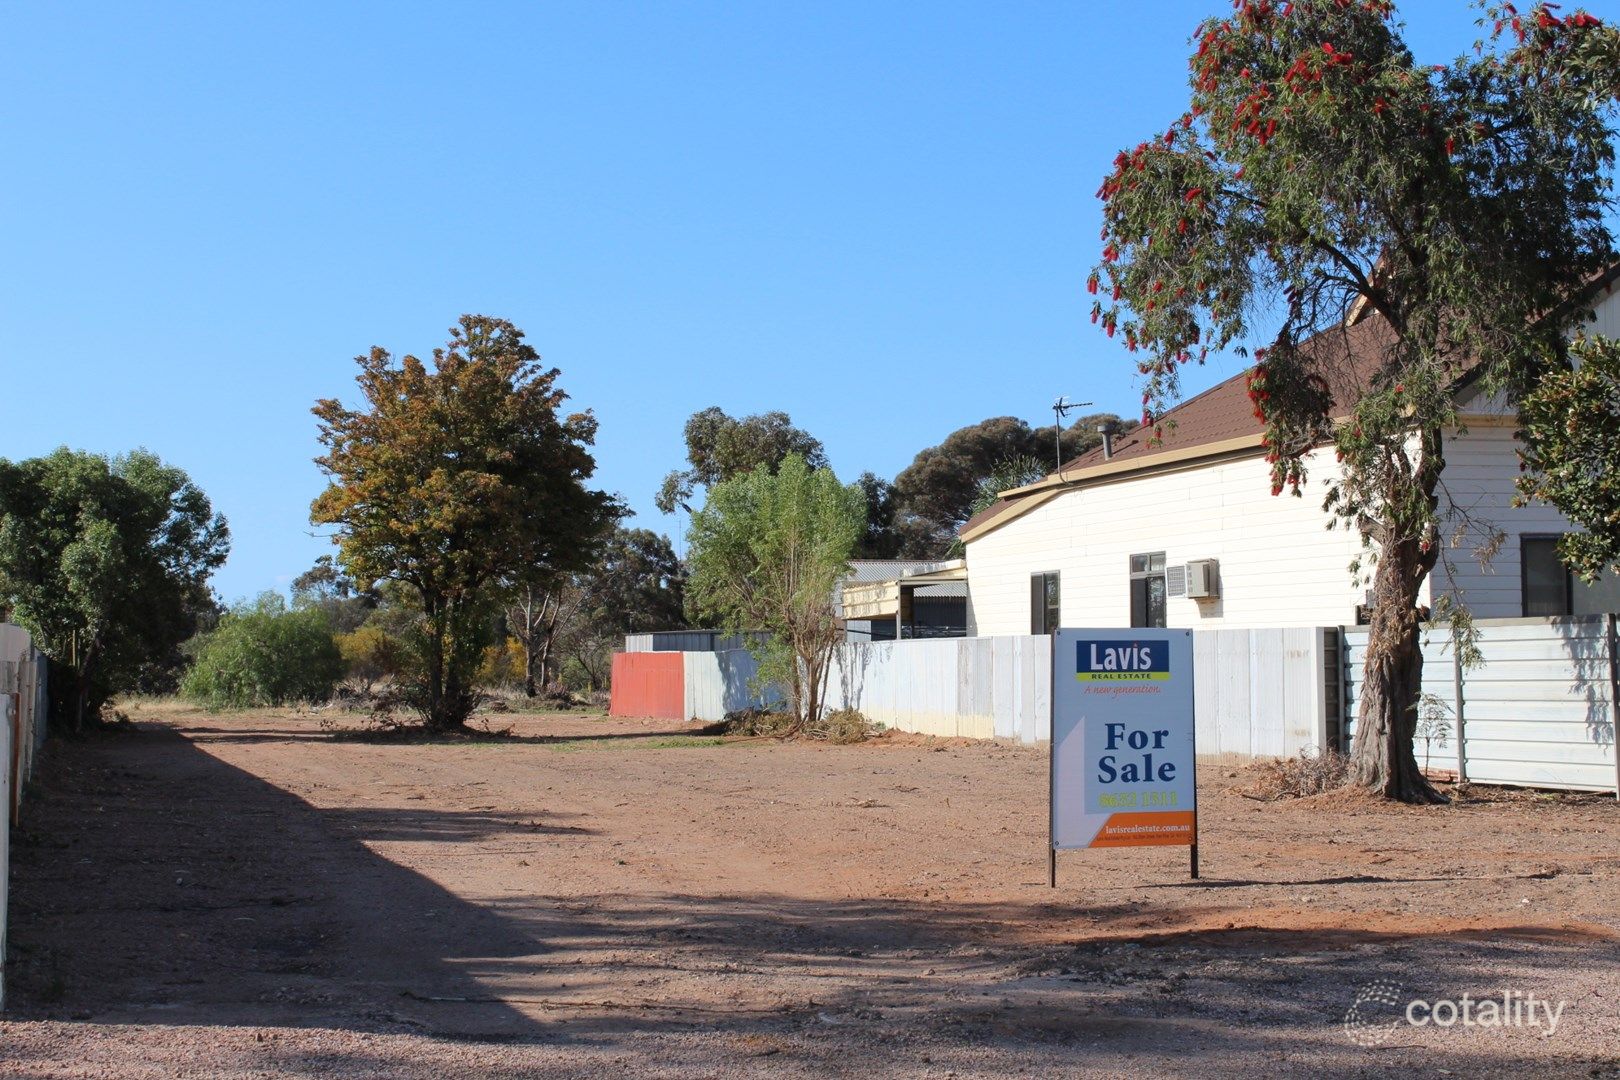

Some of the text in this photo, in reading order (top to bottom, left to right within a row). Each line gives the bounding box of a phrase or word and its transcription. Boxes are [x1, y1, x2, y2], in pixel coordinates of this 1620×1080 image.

[1090, 642, 1152, 671] Lavis
[1084, 686, 1091, 694] A
[1104, 722, 1170, 751] For
[1097, 753, 1176, 784] Sale
[1105, 825, 1190, 834] lavisrealestate.com.au
